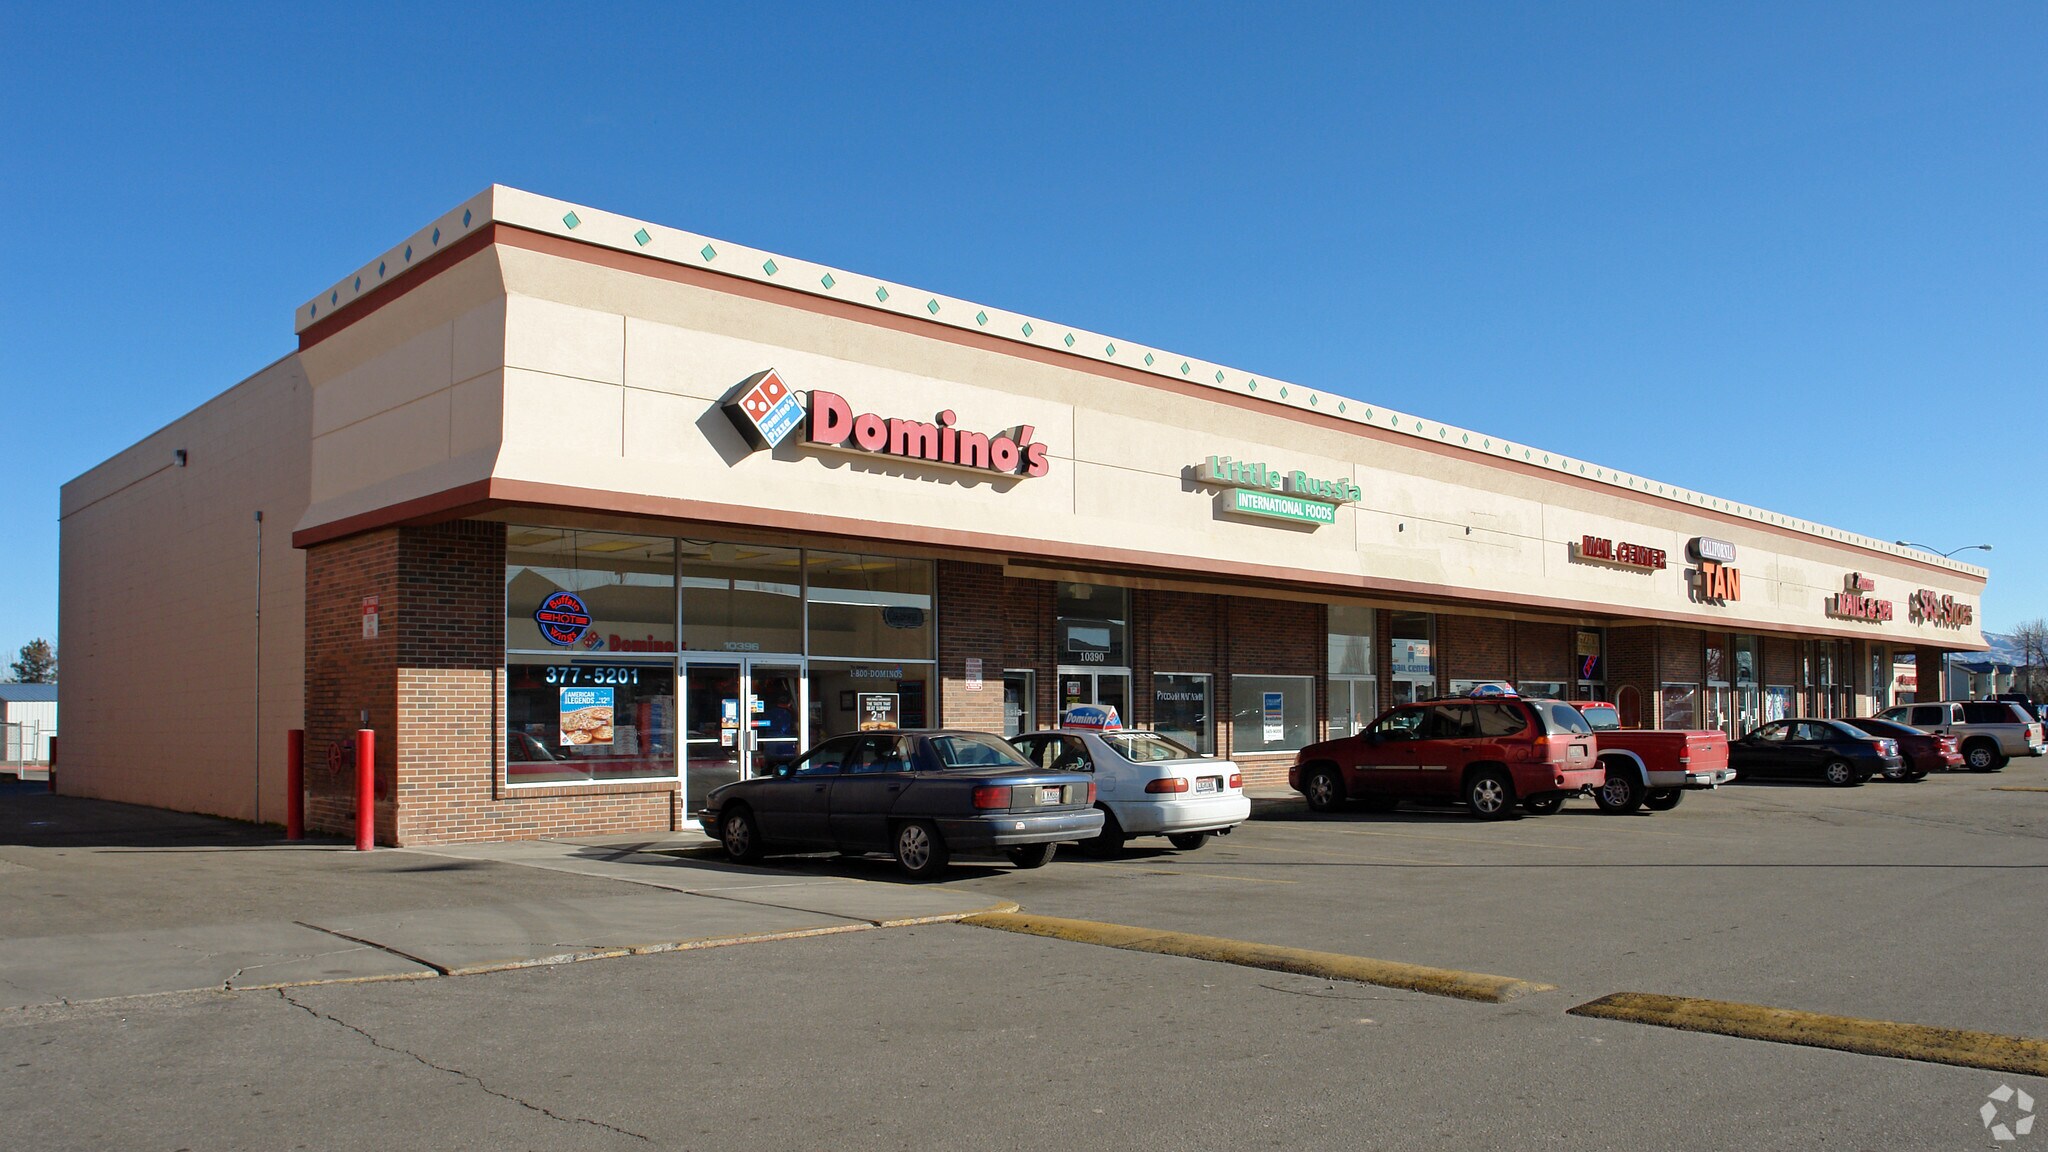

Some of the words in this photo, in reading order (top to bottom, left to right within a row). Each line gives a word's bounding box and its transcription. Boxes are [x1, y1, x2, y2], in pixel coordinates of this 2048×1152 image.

[760, 398, 795, 433] Domino's
[767, 417, 791, 442] Pizza
[808, 389, 1049, 478] Domino's
[1209, 455, 1280, 488] Little
[1292, 470, 1361, 501] Russia
[1238, 492, 1304, 517] INTERNATIONAL
[1305, 505, 1332, 521] FOODS
[1583, 535, 1613, 561] MAIL
[1616, 541, 1667, 570] CENTER
[1701, 539, 1734, 560] CALIFORNIA
[1702, 562, 1741, 601] TAN
[549, 594, 580, 612] Buffalo
[1839, 592, 1866, 617] NAILS
[552, 613, 577, 624] HOT
[550, 626, 577, 643] Wings
[723, 641, 760, 651] 10396
[1080, 652, 1105, 663] 10390
[546, 666, 638, 684] 377-5201
[850, 669, 903, 679] 1-800-DOMINOS
[871, 710, 877, 721] 2
[882, 710, 886, 721] 1
[1004, 706, 1022, 717] ssia
[1065, 712, 1105, 725] Domino's
